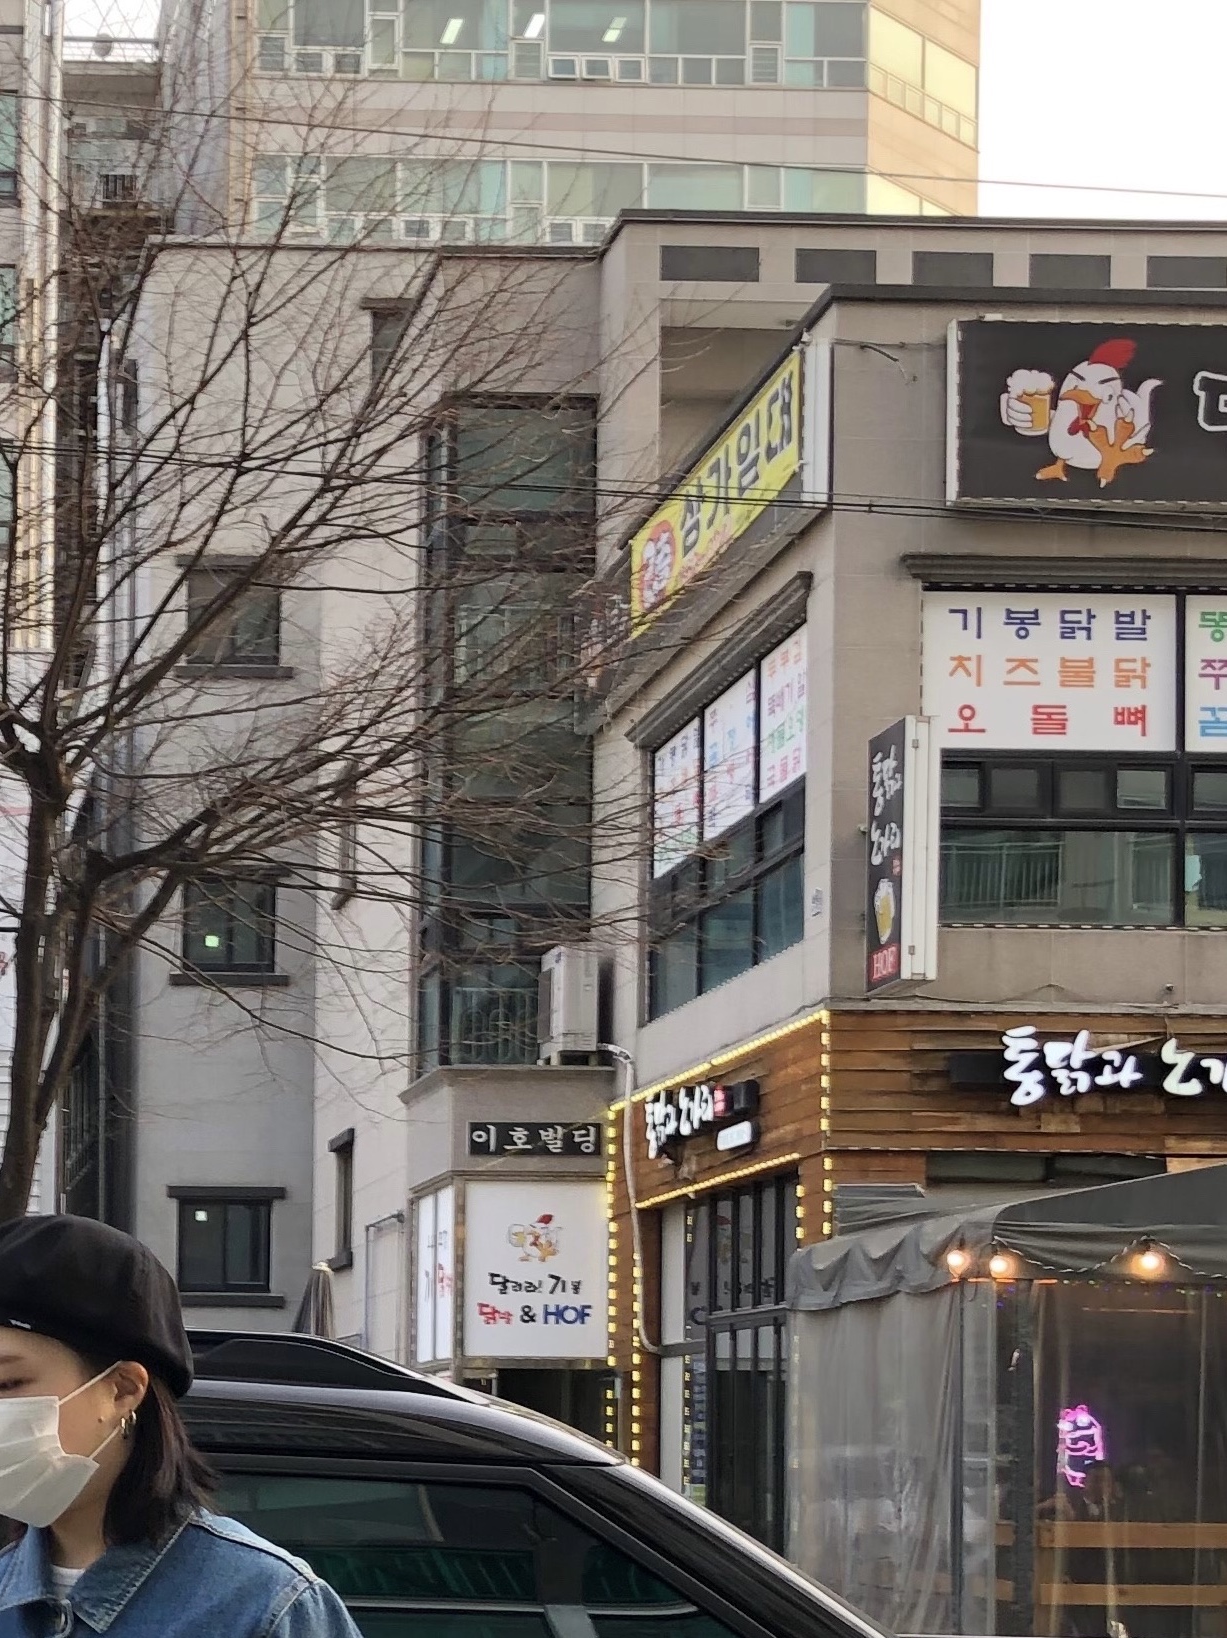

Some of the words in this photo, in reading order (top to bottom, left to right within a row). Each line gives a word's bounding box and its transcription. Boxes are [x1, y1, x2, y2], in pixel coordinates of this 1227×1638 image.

[948, 607, 1151, 640] 기봉닭발
[948, 655, 1151, 689] 치즈불닭
[948, 704, 1148, 737] 오돌뼈
[871, 946, 897, 980] HOF
[1001, 1025, 1143, 1106] 통닭과
[472, 1125, 596, 1153] 이호빌딩
[519, 1304, 537, 1323] &
[543, 1303, 593, 1325] HOF
